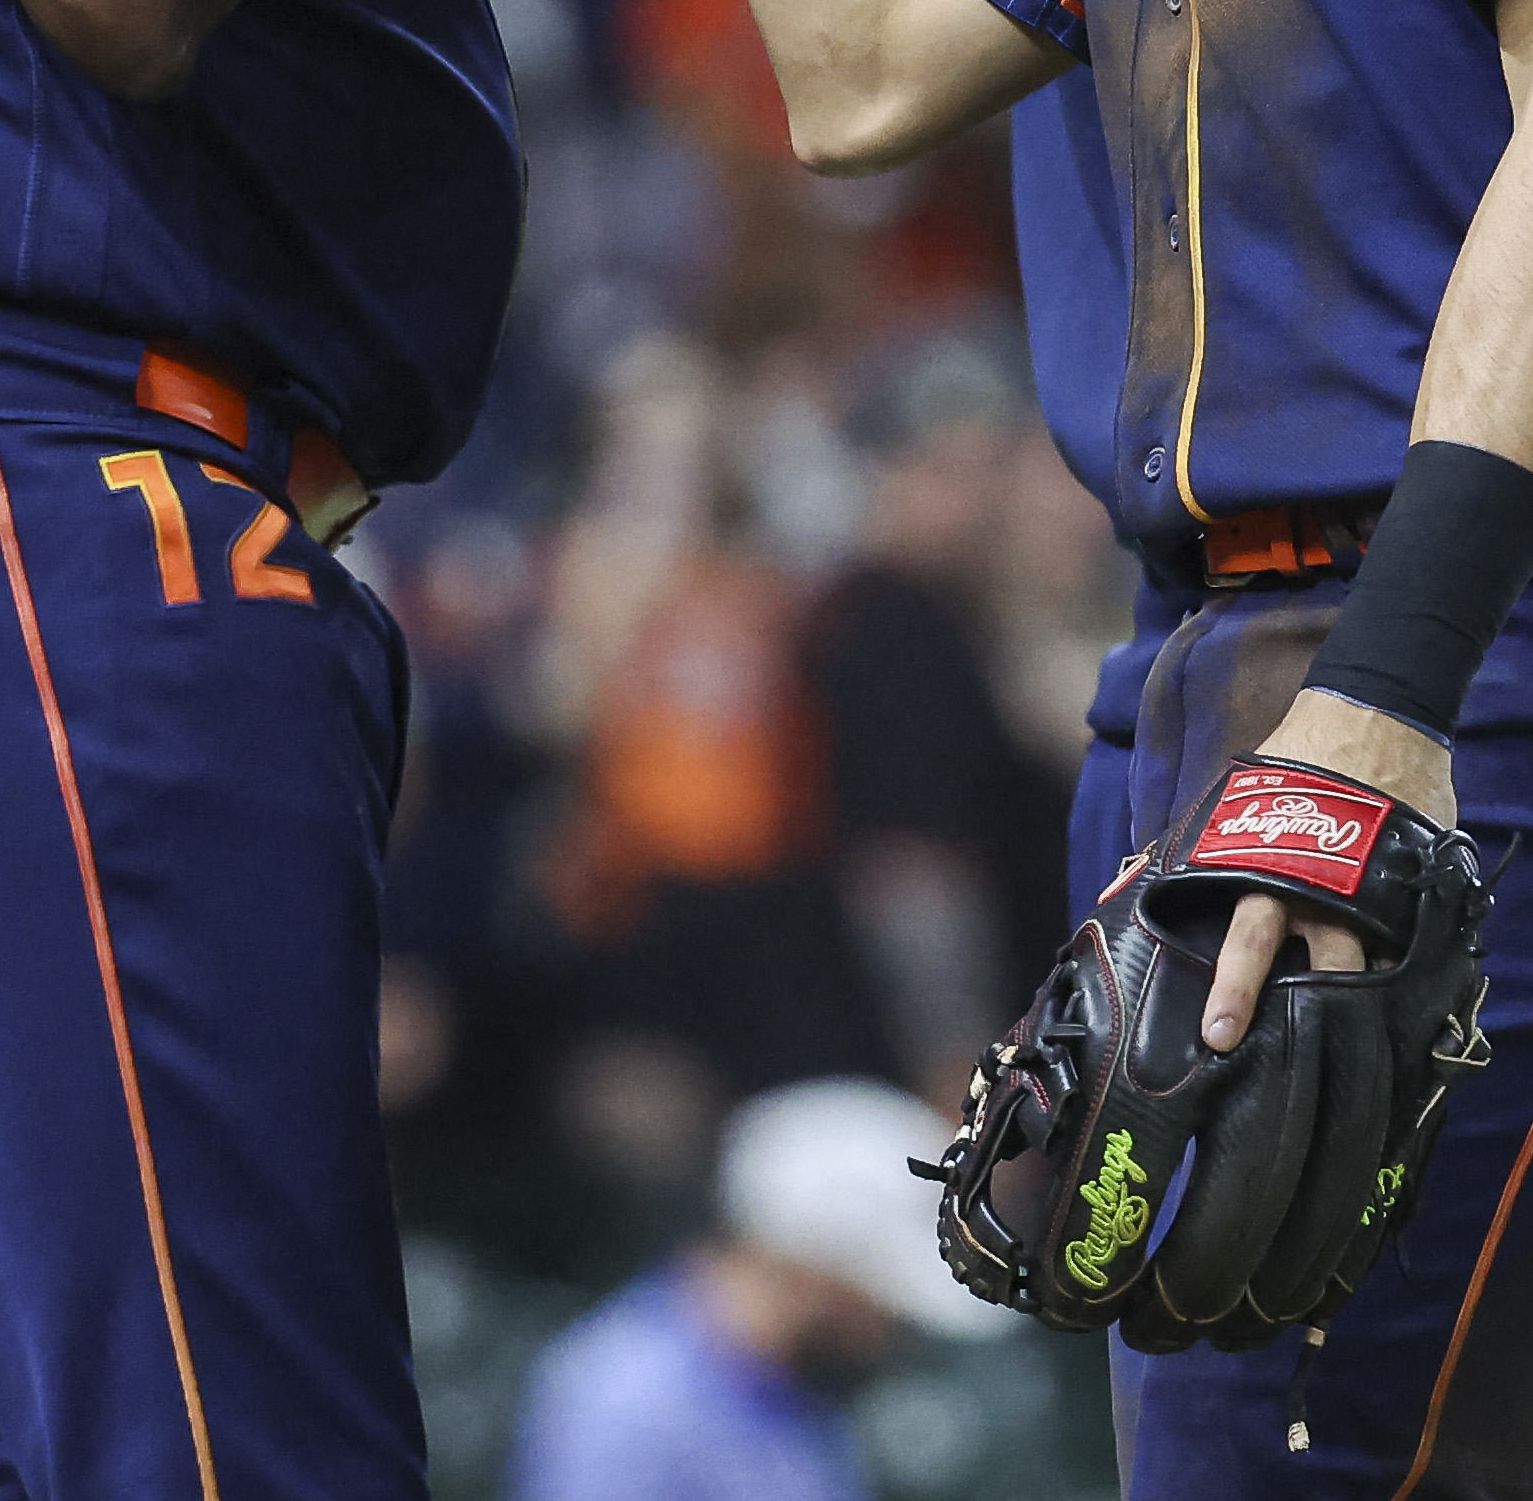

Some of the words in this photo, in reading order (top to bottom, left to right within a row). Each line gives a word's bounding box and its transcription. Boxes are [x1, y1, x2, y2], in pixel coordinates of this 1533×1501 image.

[98, 449, 316, 605] 12
[1218, 798, 1362, 853] Rawlings
[1066, 1128, 1148, 1289] Rawlings
